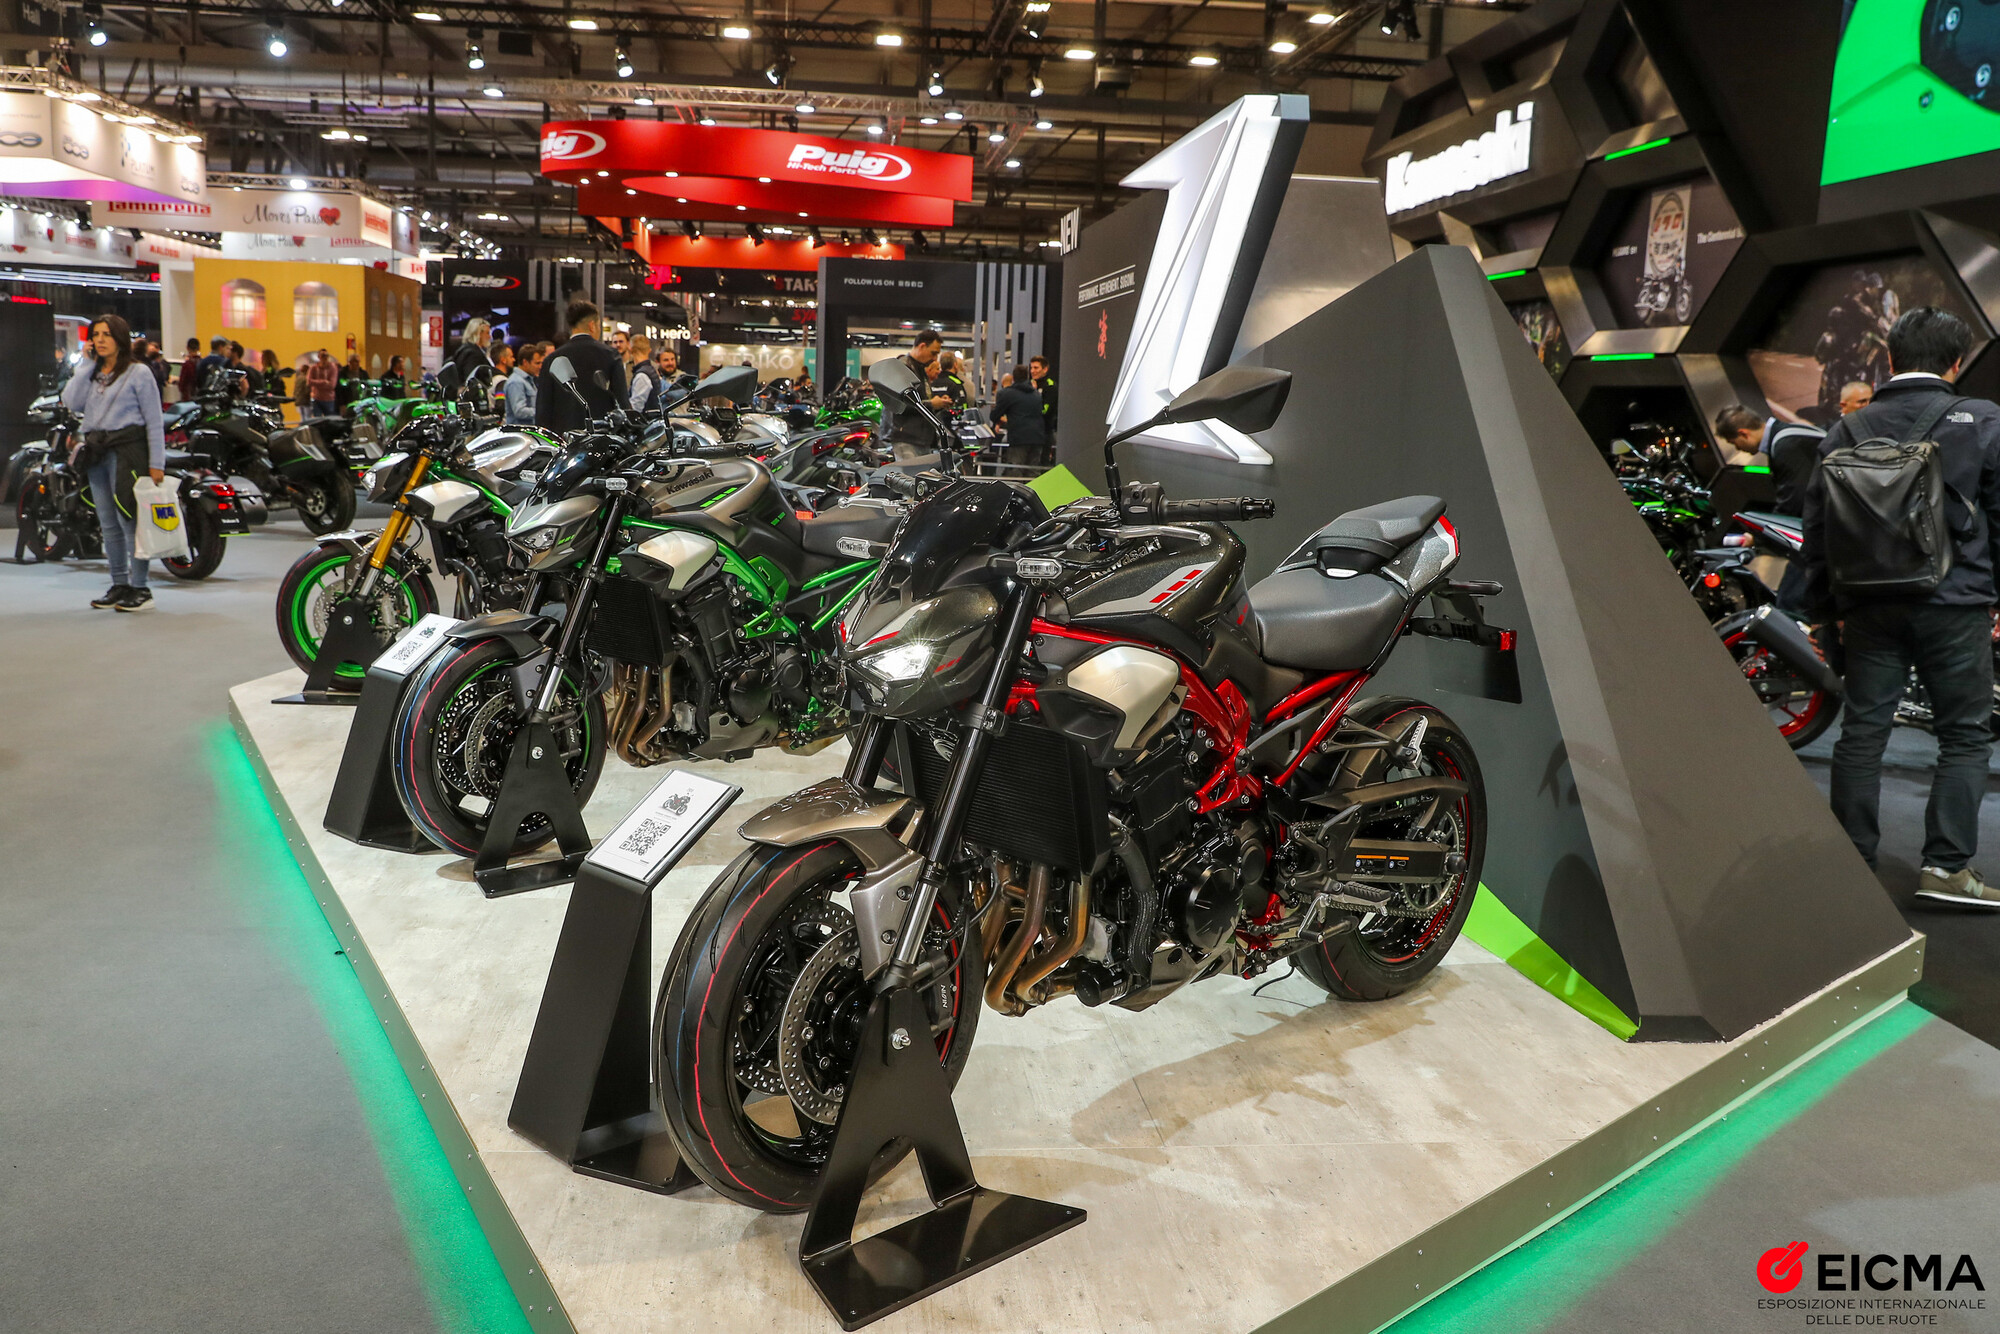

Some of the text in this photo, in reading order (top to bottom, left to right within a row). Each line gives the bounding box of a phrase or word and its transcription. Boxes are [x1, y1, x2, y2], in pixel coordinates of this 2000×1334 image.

[786, 161, 858, 175] Hi-Tech Parts
[788, 144, 889, 175] Puig
[1060, 206, 1080, 257] NEW
[453, 274, 508, 288] Puig
[666, 468, 715, 495] Kawasaki
